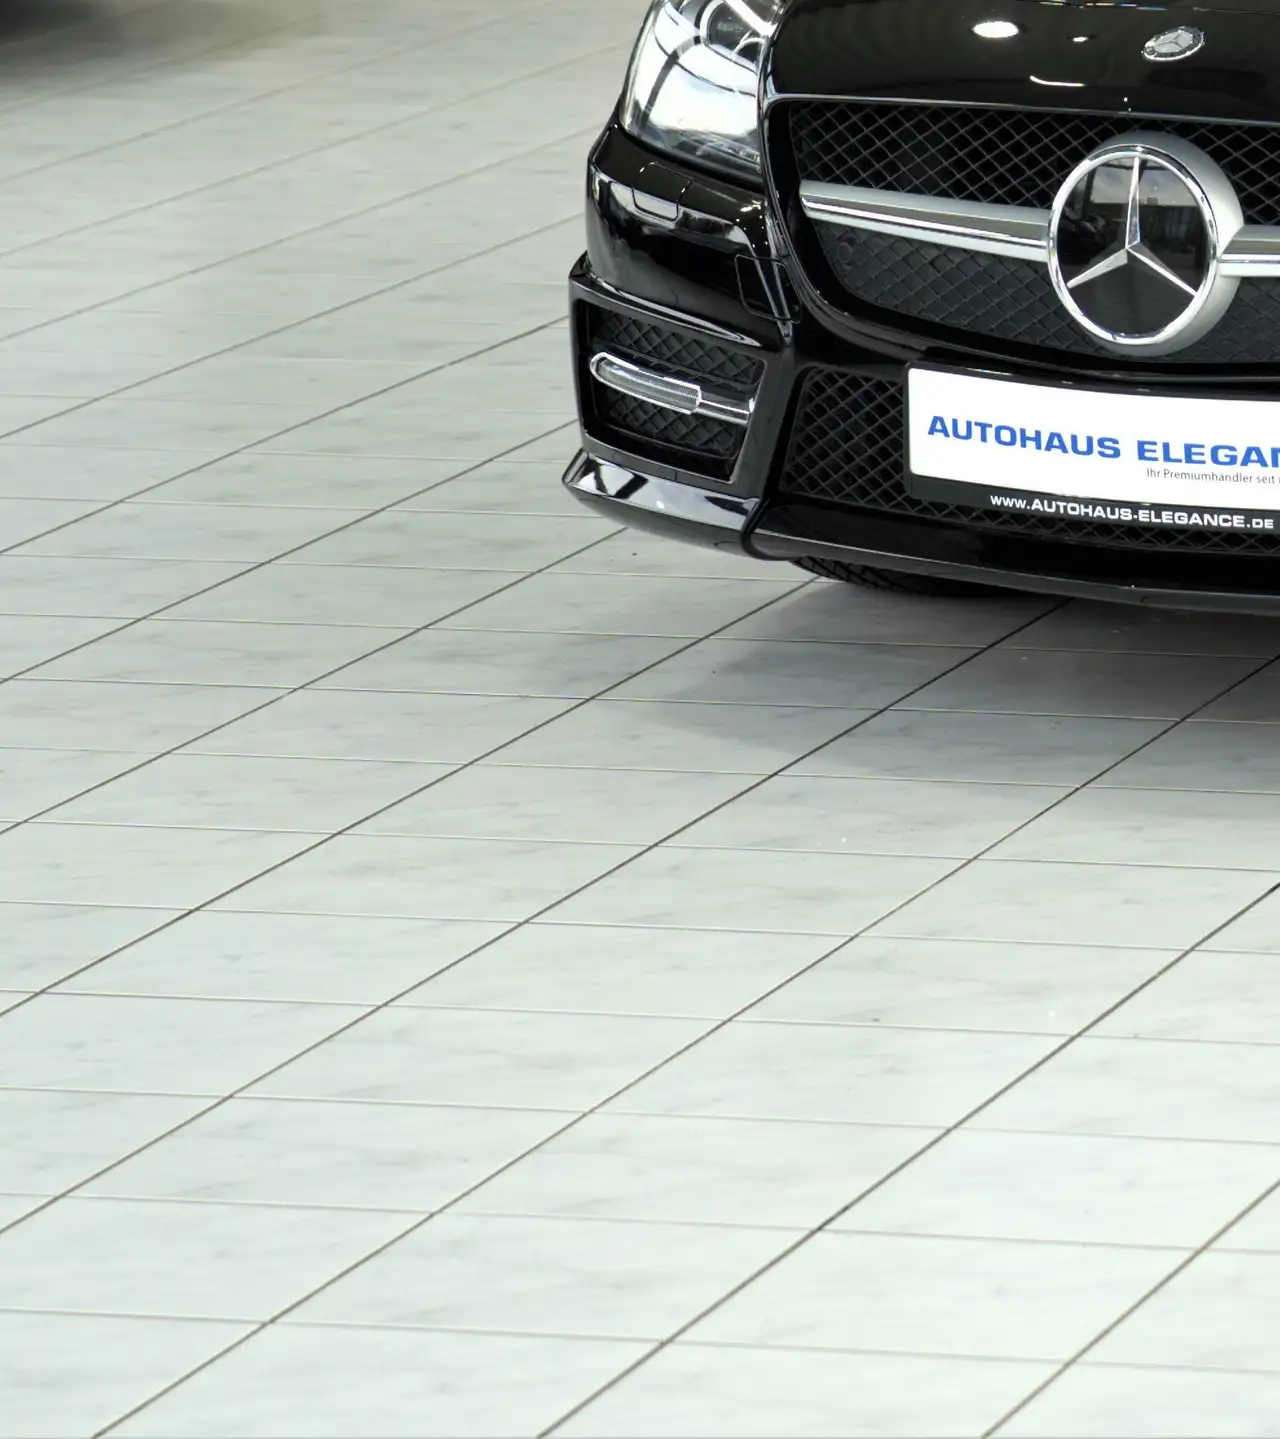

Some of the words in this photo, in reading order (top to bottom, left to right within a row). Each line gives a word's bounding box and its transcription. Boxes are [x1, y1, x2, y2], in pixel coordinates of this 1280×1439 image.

[927, 415, 1121, 459] AUTOHAUS
[1146, 468, 1161, 478] Ihr
[1163, 469, 1253, 484] Premiumhändler
[1256, 473, 1276, 484] seit
